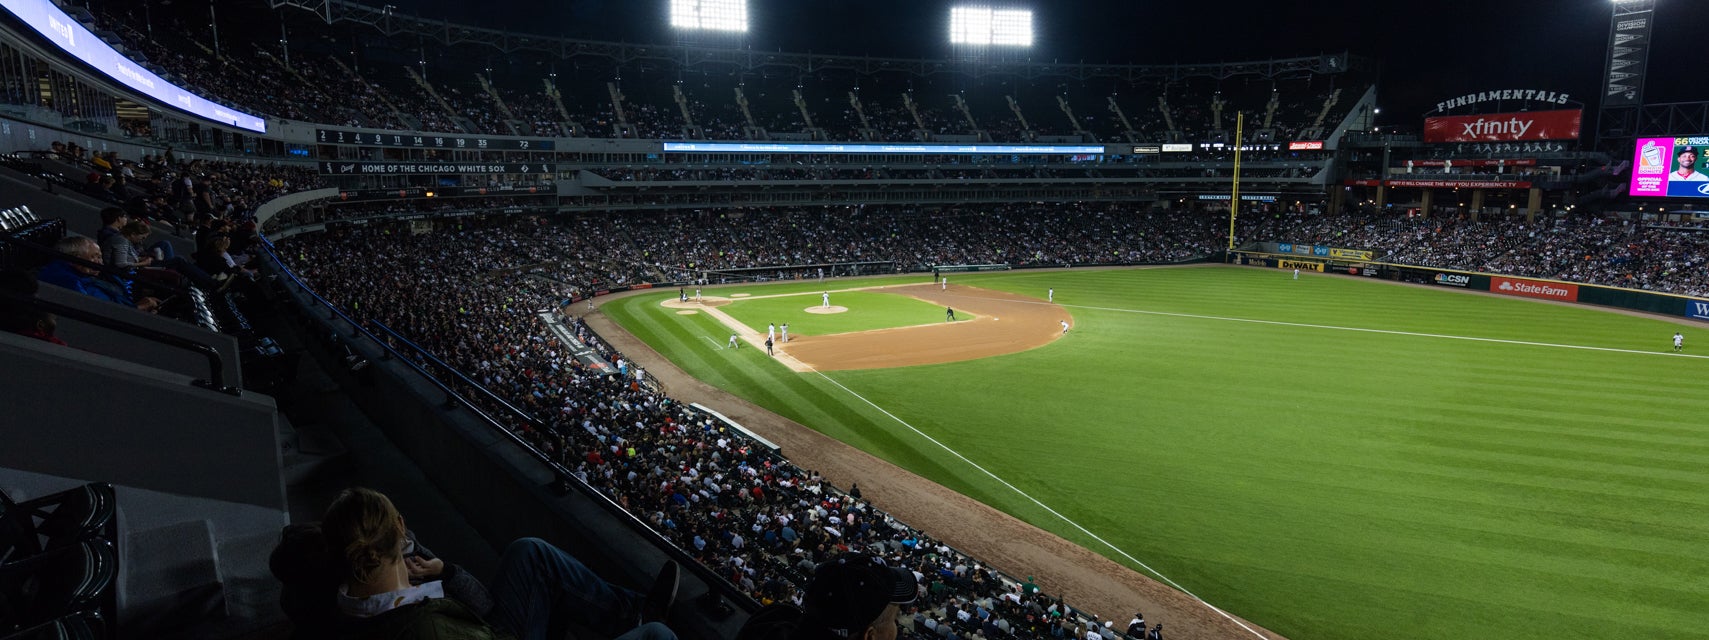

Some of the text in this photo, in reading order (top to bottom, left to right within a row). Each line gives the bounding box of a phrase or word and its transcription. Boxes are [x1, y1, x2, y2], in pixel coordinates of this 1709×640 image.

[1437, 89, 1569, 113] FUNDAMENTALS
[1462, 117, 1534, 139] xfinity
[320, 130, 326, 139] 2
[338, 132, 343, 140] 3
[375, 134, 381, 142] 9
[394, 135, 401, 143] 11
[413, 136, 423, 144] 14
[1675, 137, 1689, 145] 66
[519, 140, 529, 148] 72
[361, 165, 386, 173] HOME
[387, 165, 398, 173] OF
[400, 165, 416, 173] THE
[418, 165, 456, 173] CHICAGO
[457, 165, 487, 173] WHITE
[488, 165, 505, 173] SOX
[1447, 274, 1470, 284] CSN
[1514, 282, 1568, 297] State Farm
